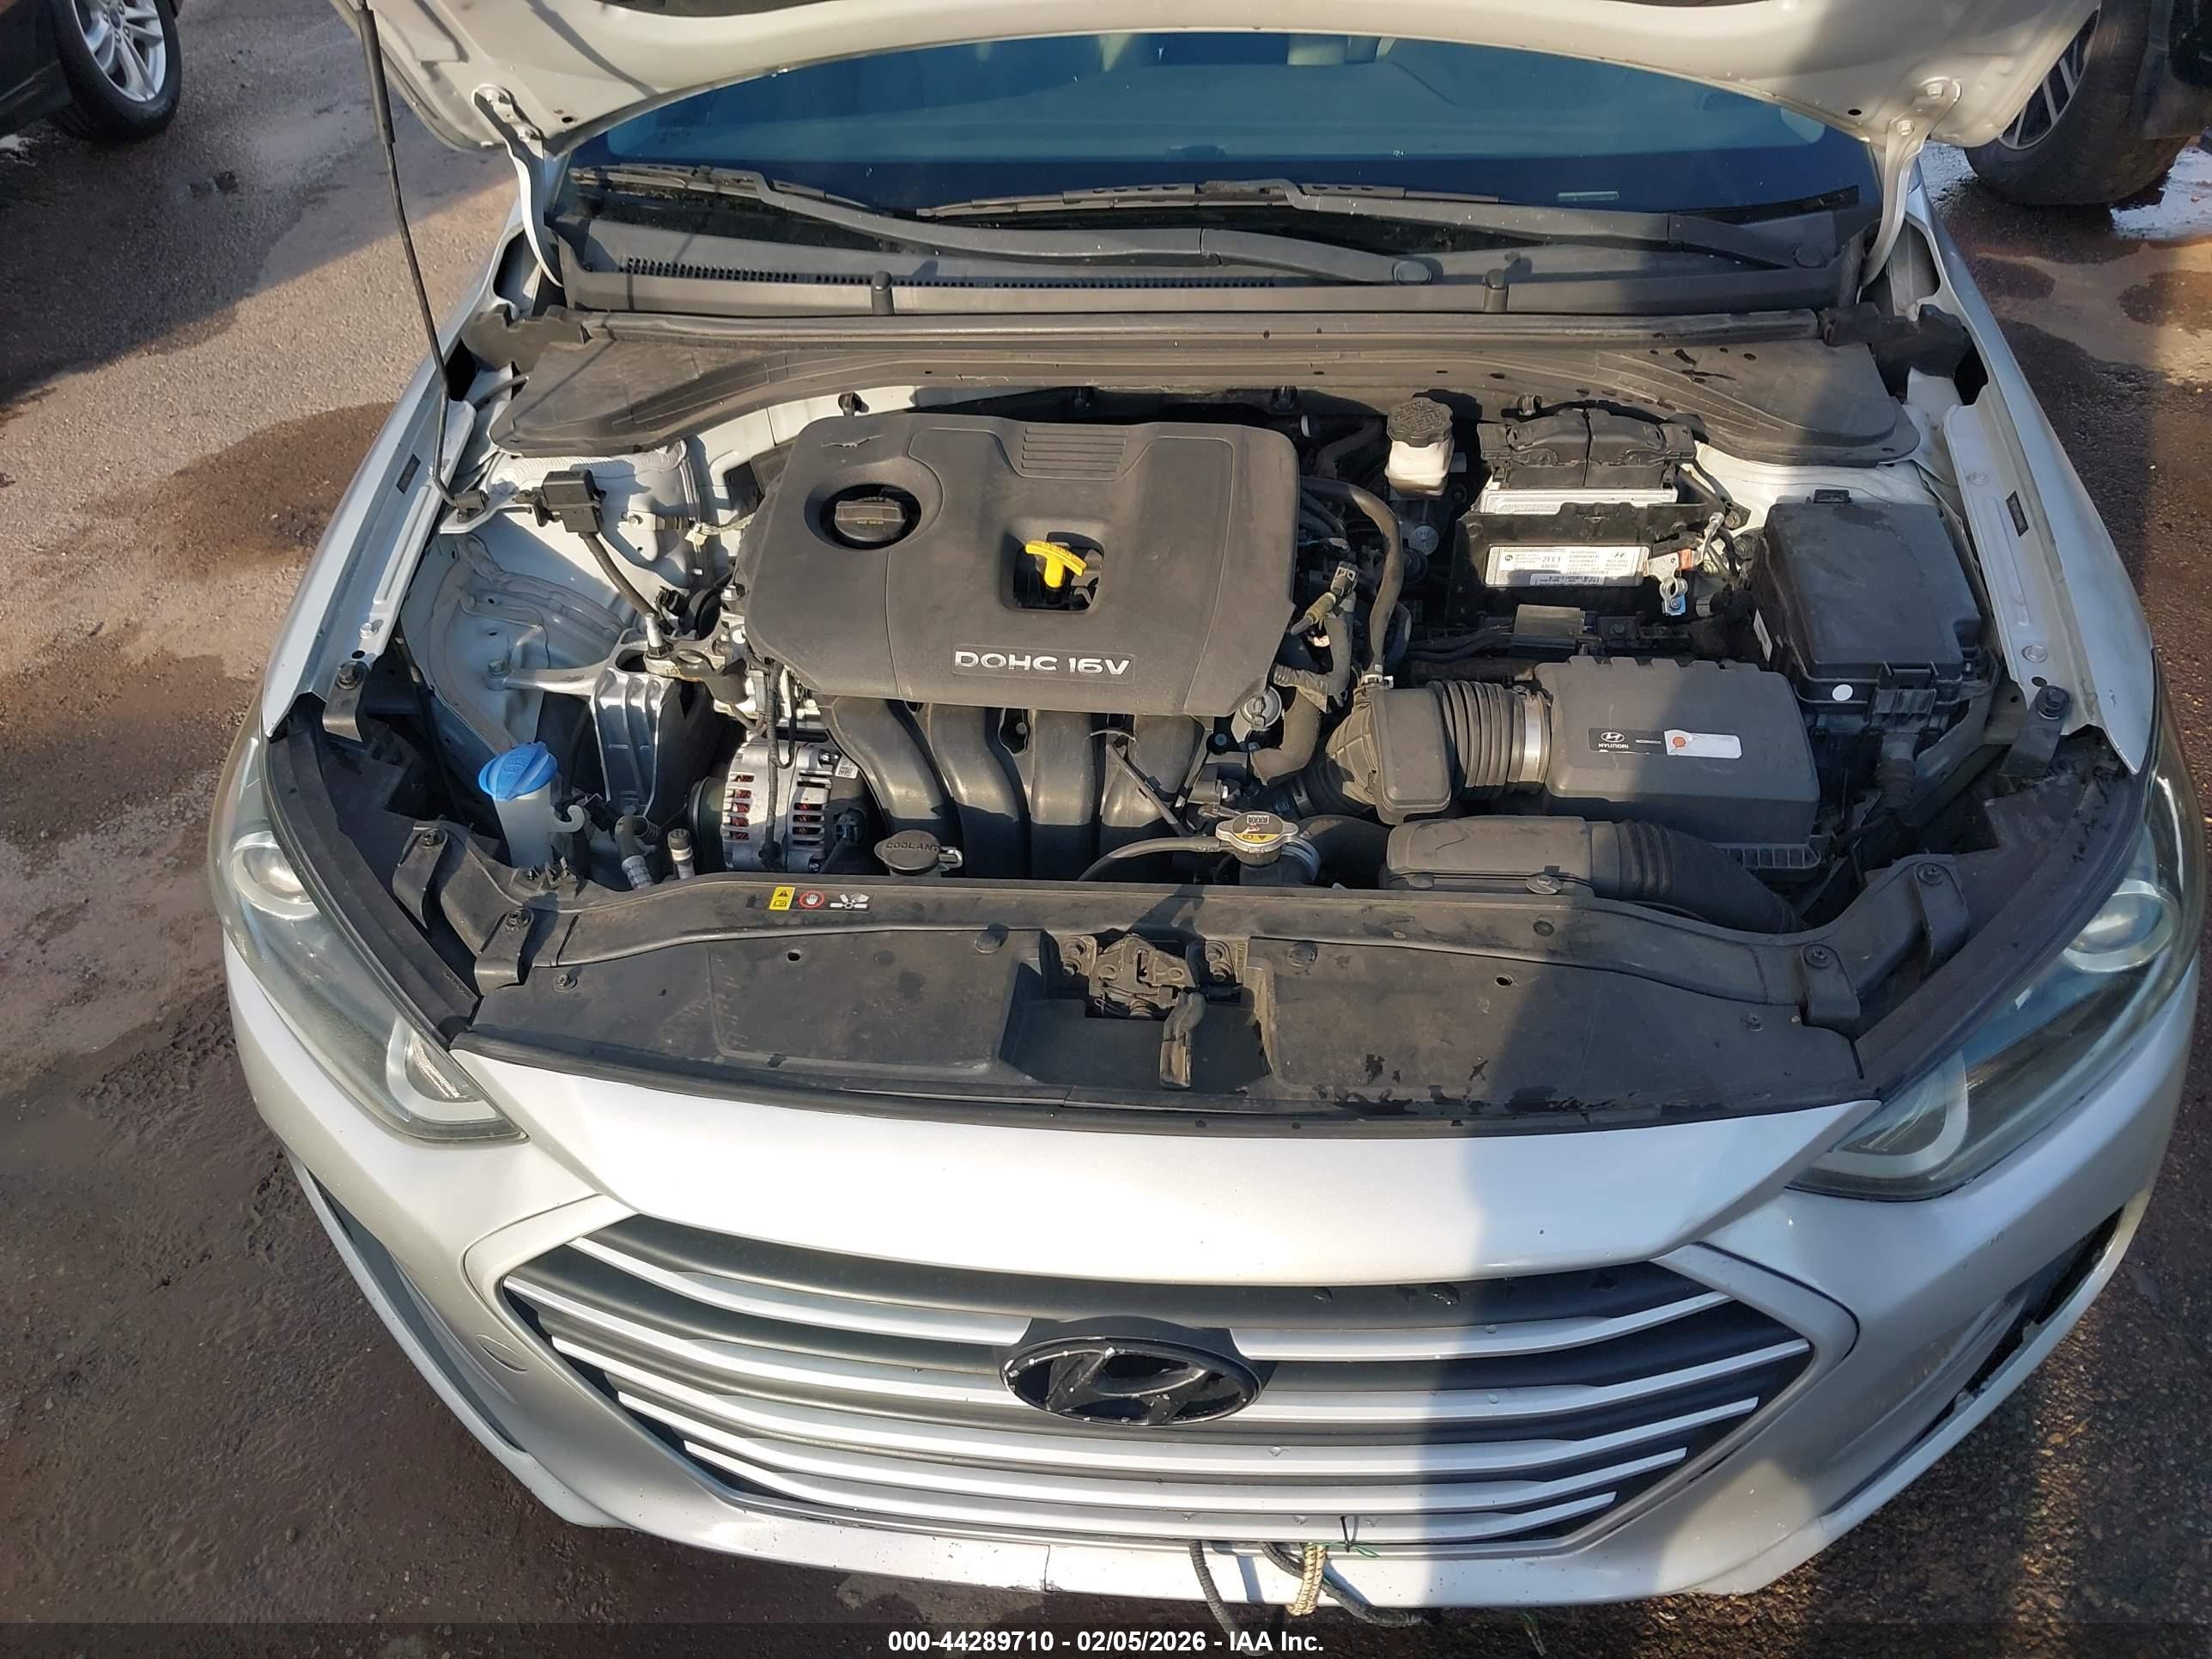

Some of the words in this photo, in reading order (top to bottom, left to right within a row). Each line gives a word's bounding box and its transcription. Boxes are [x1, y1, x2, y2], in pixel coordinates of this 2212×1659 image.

[955, 651, 1058, 672] DOHC
[1068, 657, 1131, 675] 16V
[886, 842, 940, 853] COOLANT
